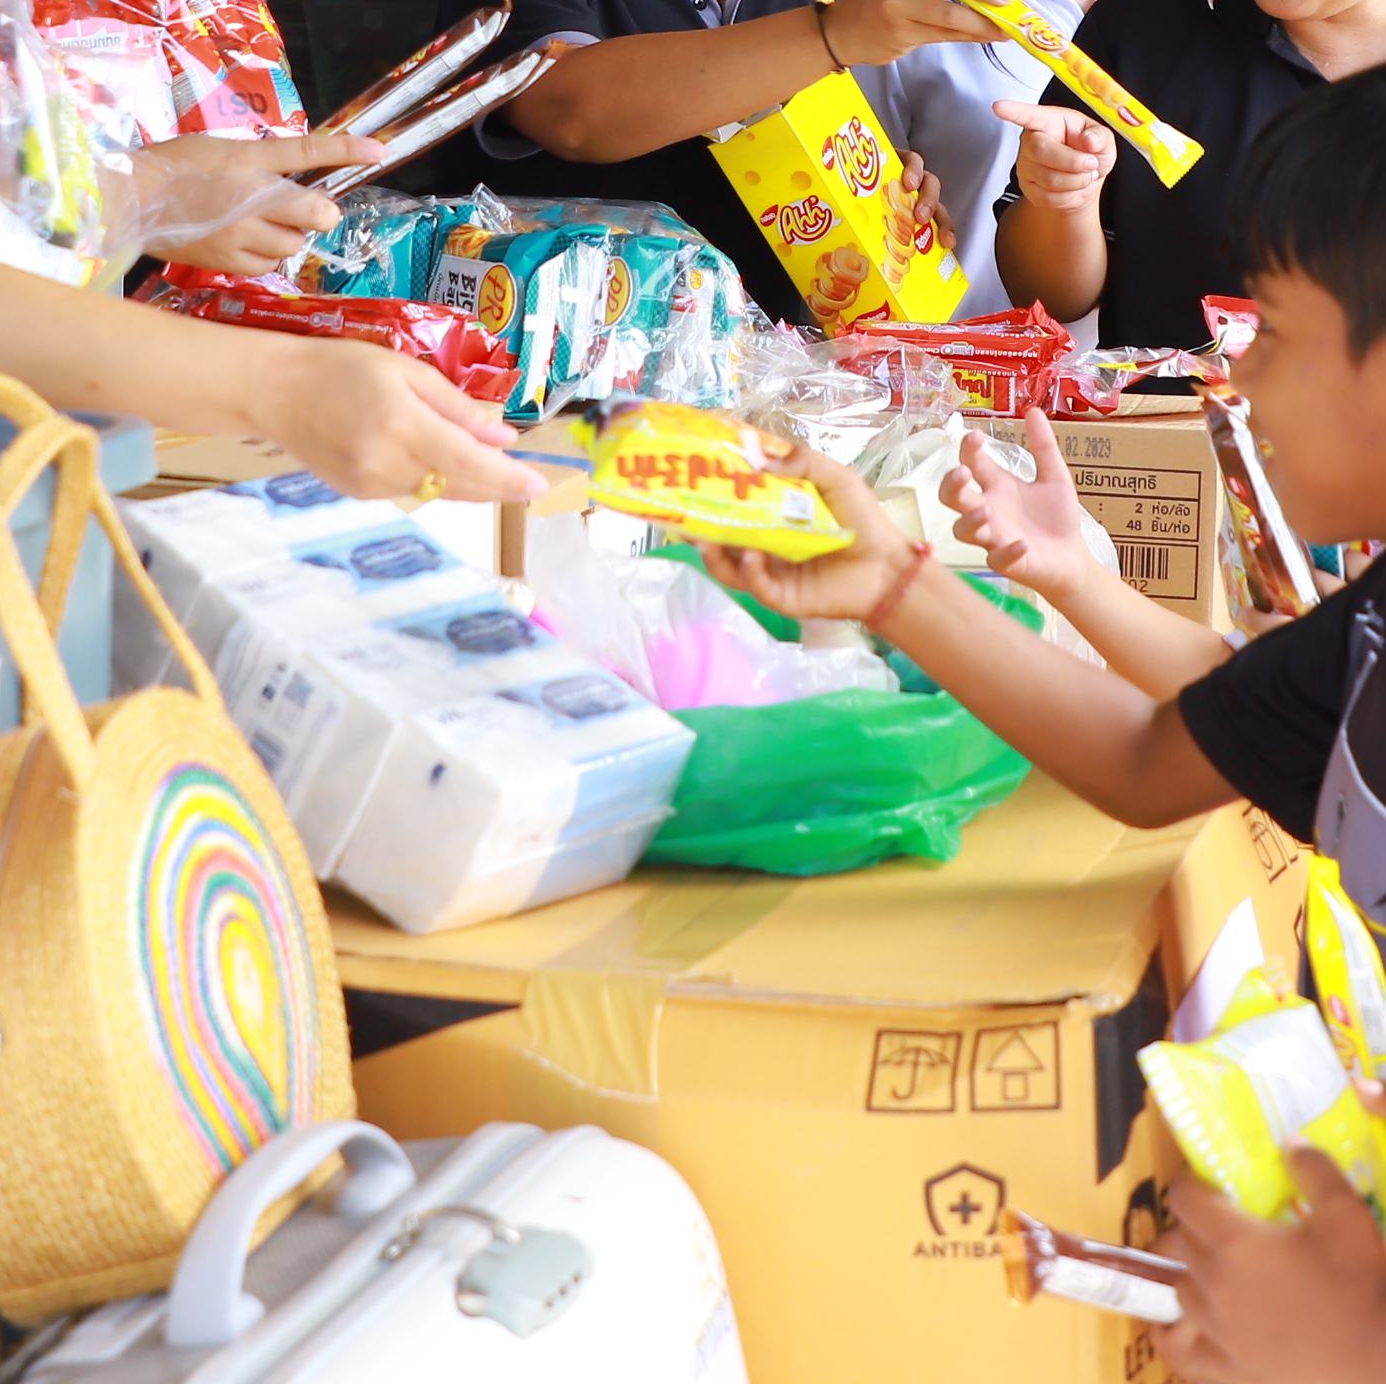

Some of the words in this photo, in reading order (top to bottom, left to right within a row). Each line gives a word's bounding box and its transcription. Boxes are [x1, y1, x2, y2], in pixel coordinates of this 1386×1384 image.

[1058, 433, 1112, 459] .02.2029
[1075, 470, 1157, 494] ปริมาณสุทธิ
[1135, 503, 1144, 514] 2
[1151, 502, 1191, 517] ห่อ/ลัง
[1126, 520, 1143, 532] 48
[1151, 517, 1191, 533] ชิ้น/ห่อ
[913, 1241, 1005, 1258] ANTIBA
